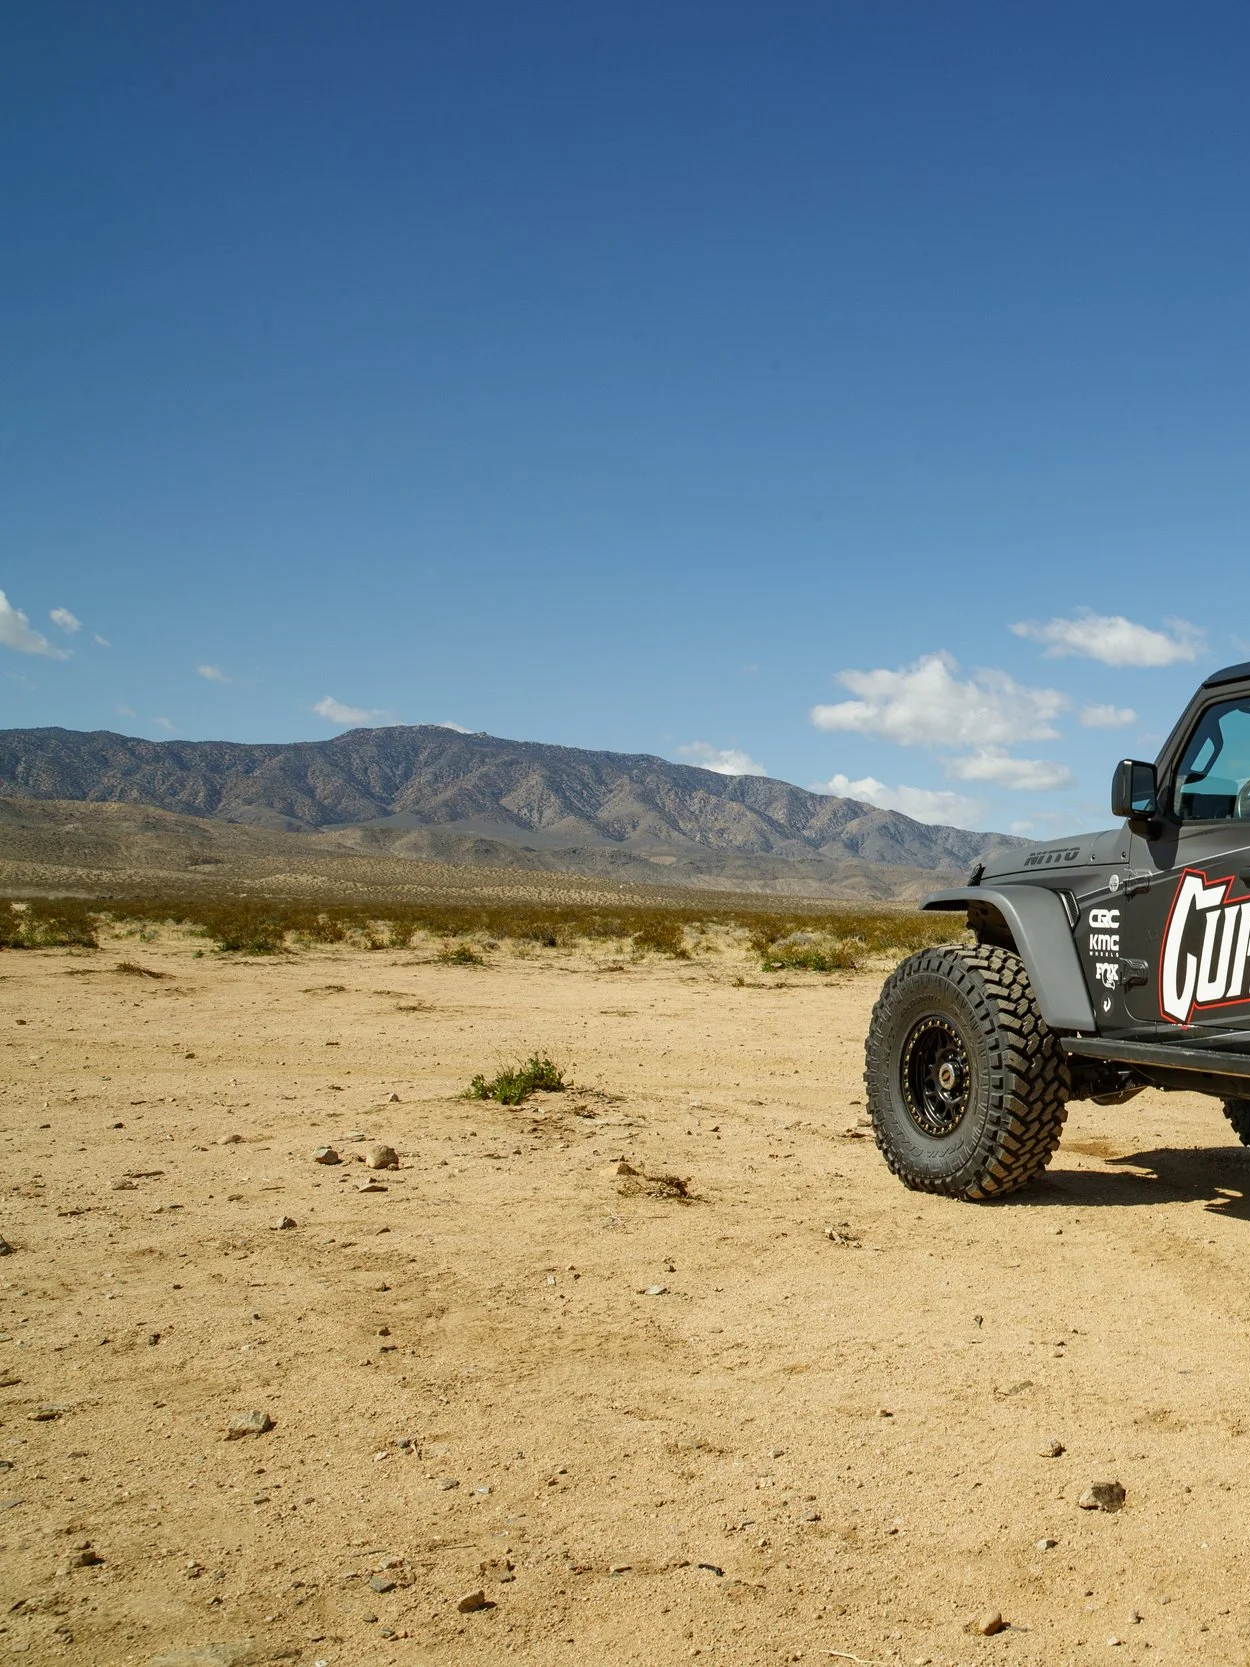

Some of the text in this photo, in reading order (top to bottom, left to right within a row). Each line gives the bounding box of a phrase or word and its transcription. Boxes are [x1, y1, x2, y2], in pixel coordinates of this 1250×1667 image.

[1024, 847, 1080, 866] NITTO
[1089, 909, 1120, 928] CRC
[1089, 934, 1119, 951] KMC
[1096, 962, 1119, 990] FOX
